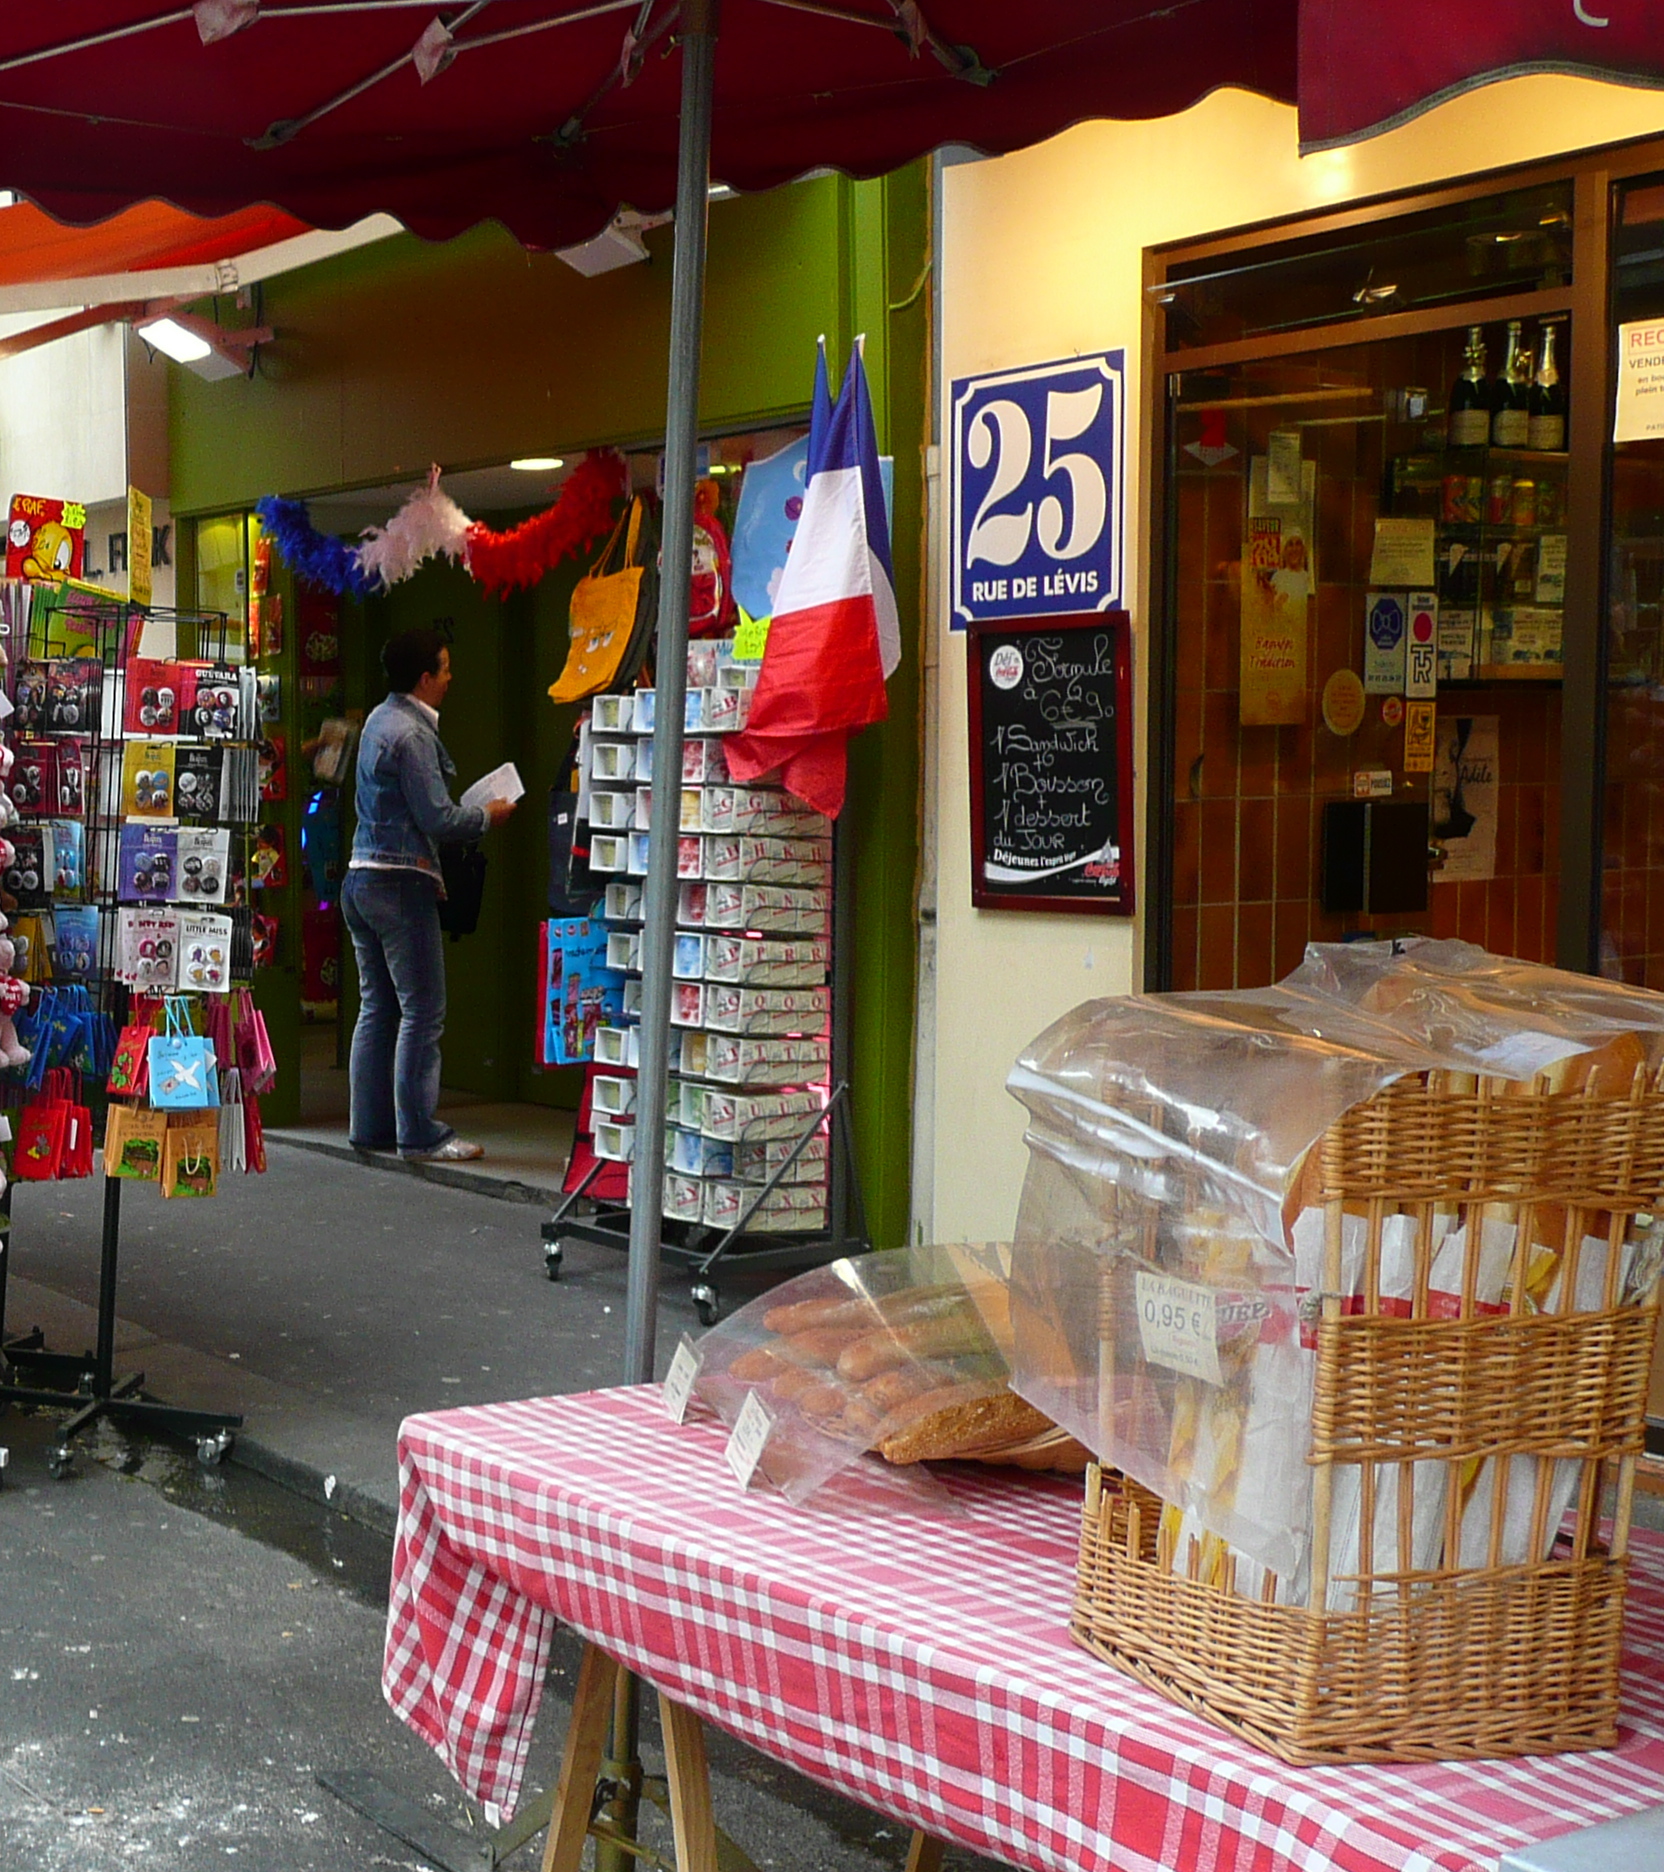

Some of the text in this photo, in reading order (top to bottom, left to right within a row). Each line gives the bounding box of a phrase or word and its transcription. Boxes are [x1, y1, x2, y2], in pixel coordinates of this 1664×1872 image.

[967, 383, 1106, 570] 25
[973, 569, 1098, 602] RUE DE LÉVIS
[1025, 634, 1112, 688] Formule
[1006, 724, 1099, 753] Sandwich
[1010, 763, 1109, 804] Boisson
[1014, 802, 1092, 827] dessert
[993, 830, 1065, 850] du JOUR
[186, 925, 205, 934] LITTLE
[1145, 1300, 1201, 1336] 0,95 €
